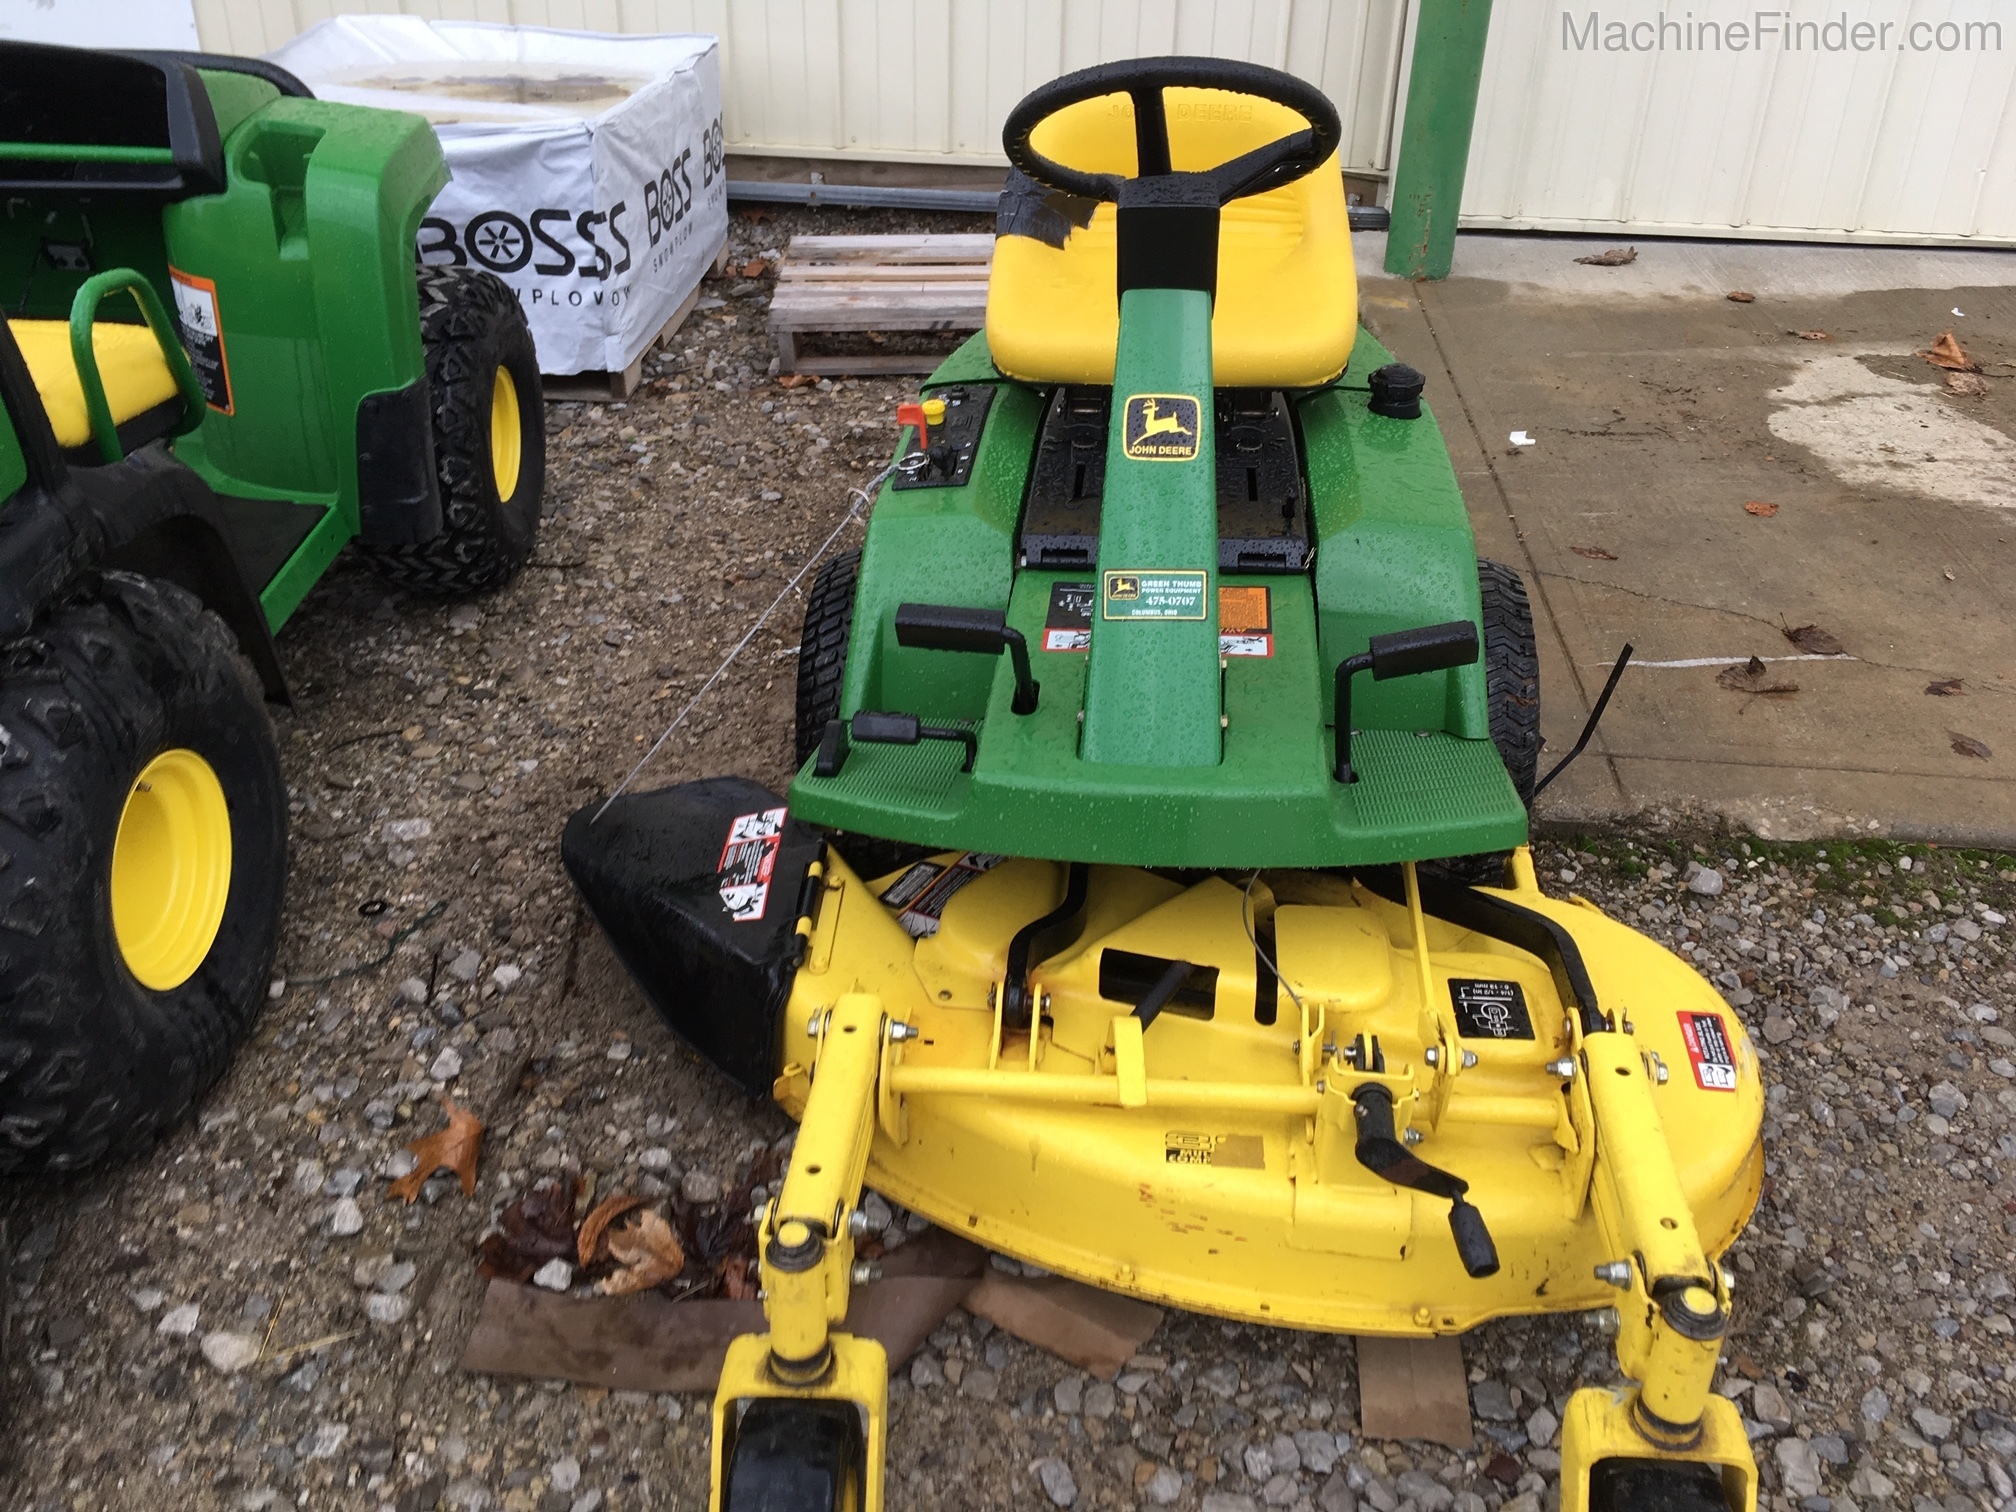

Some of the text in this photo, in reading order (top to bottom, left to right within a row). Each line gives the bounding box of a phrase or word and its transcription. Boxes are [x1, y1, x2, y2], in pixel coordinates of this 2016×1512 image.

[1177, 104, 1253, 123] DEERE
[644, 147, 692, 249] BOSS
[653, 221, 694, 274] SNOWPLOW
[1128, 445, 1192, 456] JOHN DEERE
[1141, 580, 1202, 588] GREEN THUMB
[1145, 596, 1196, 606] 475-0707
